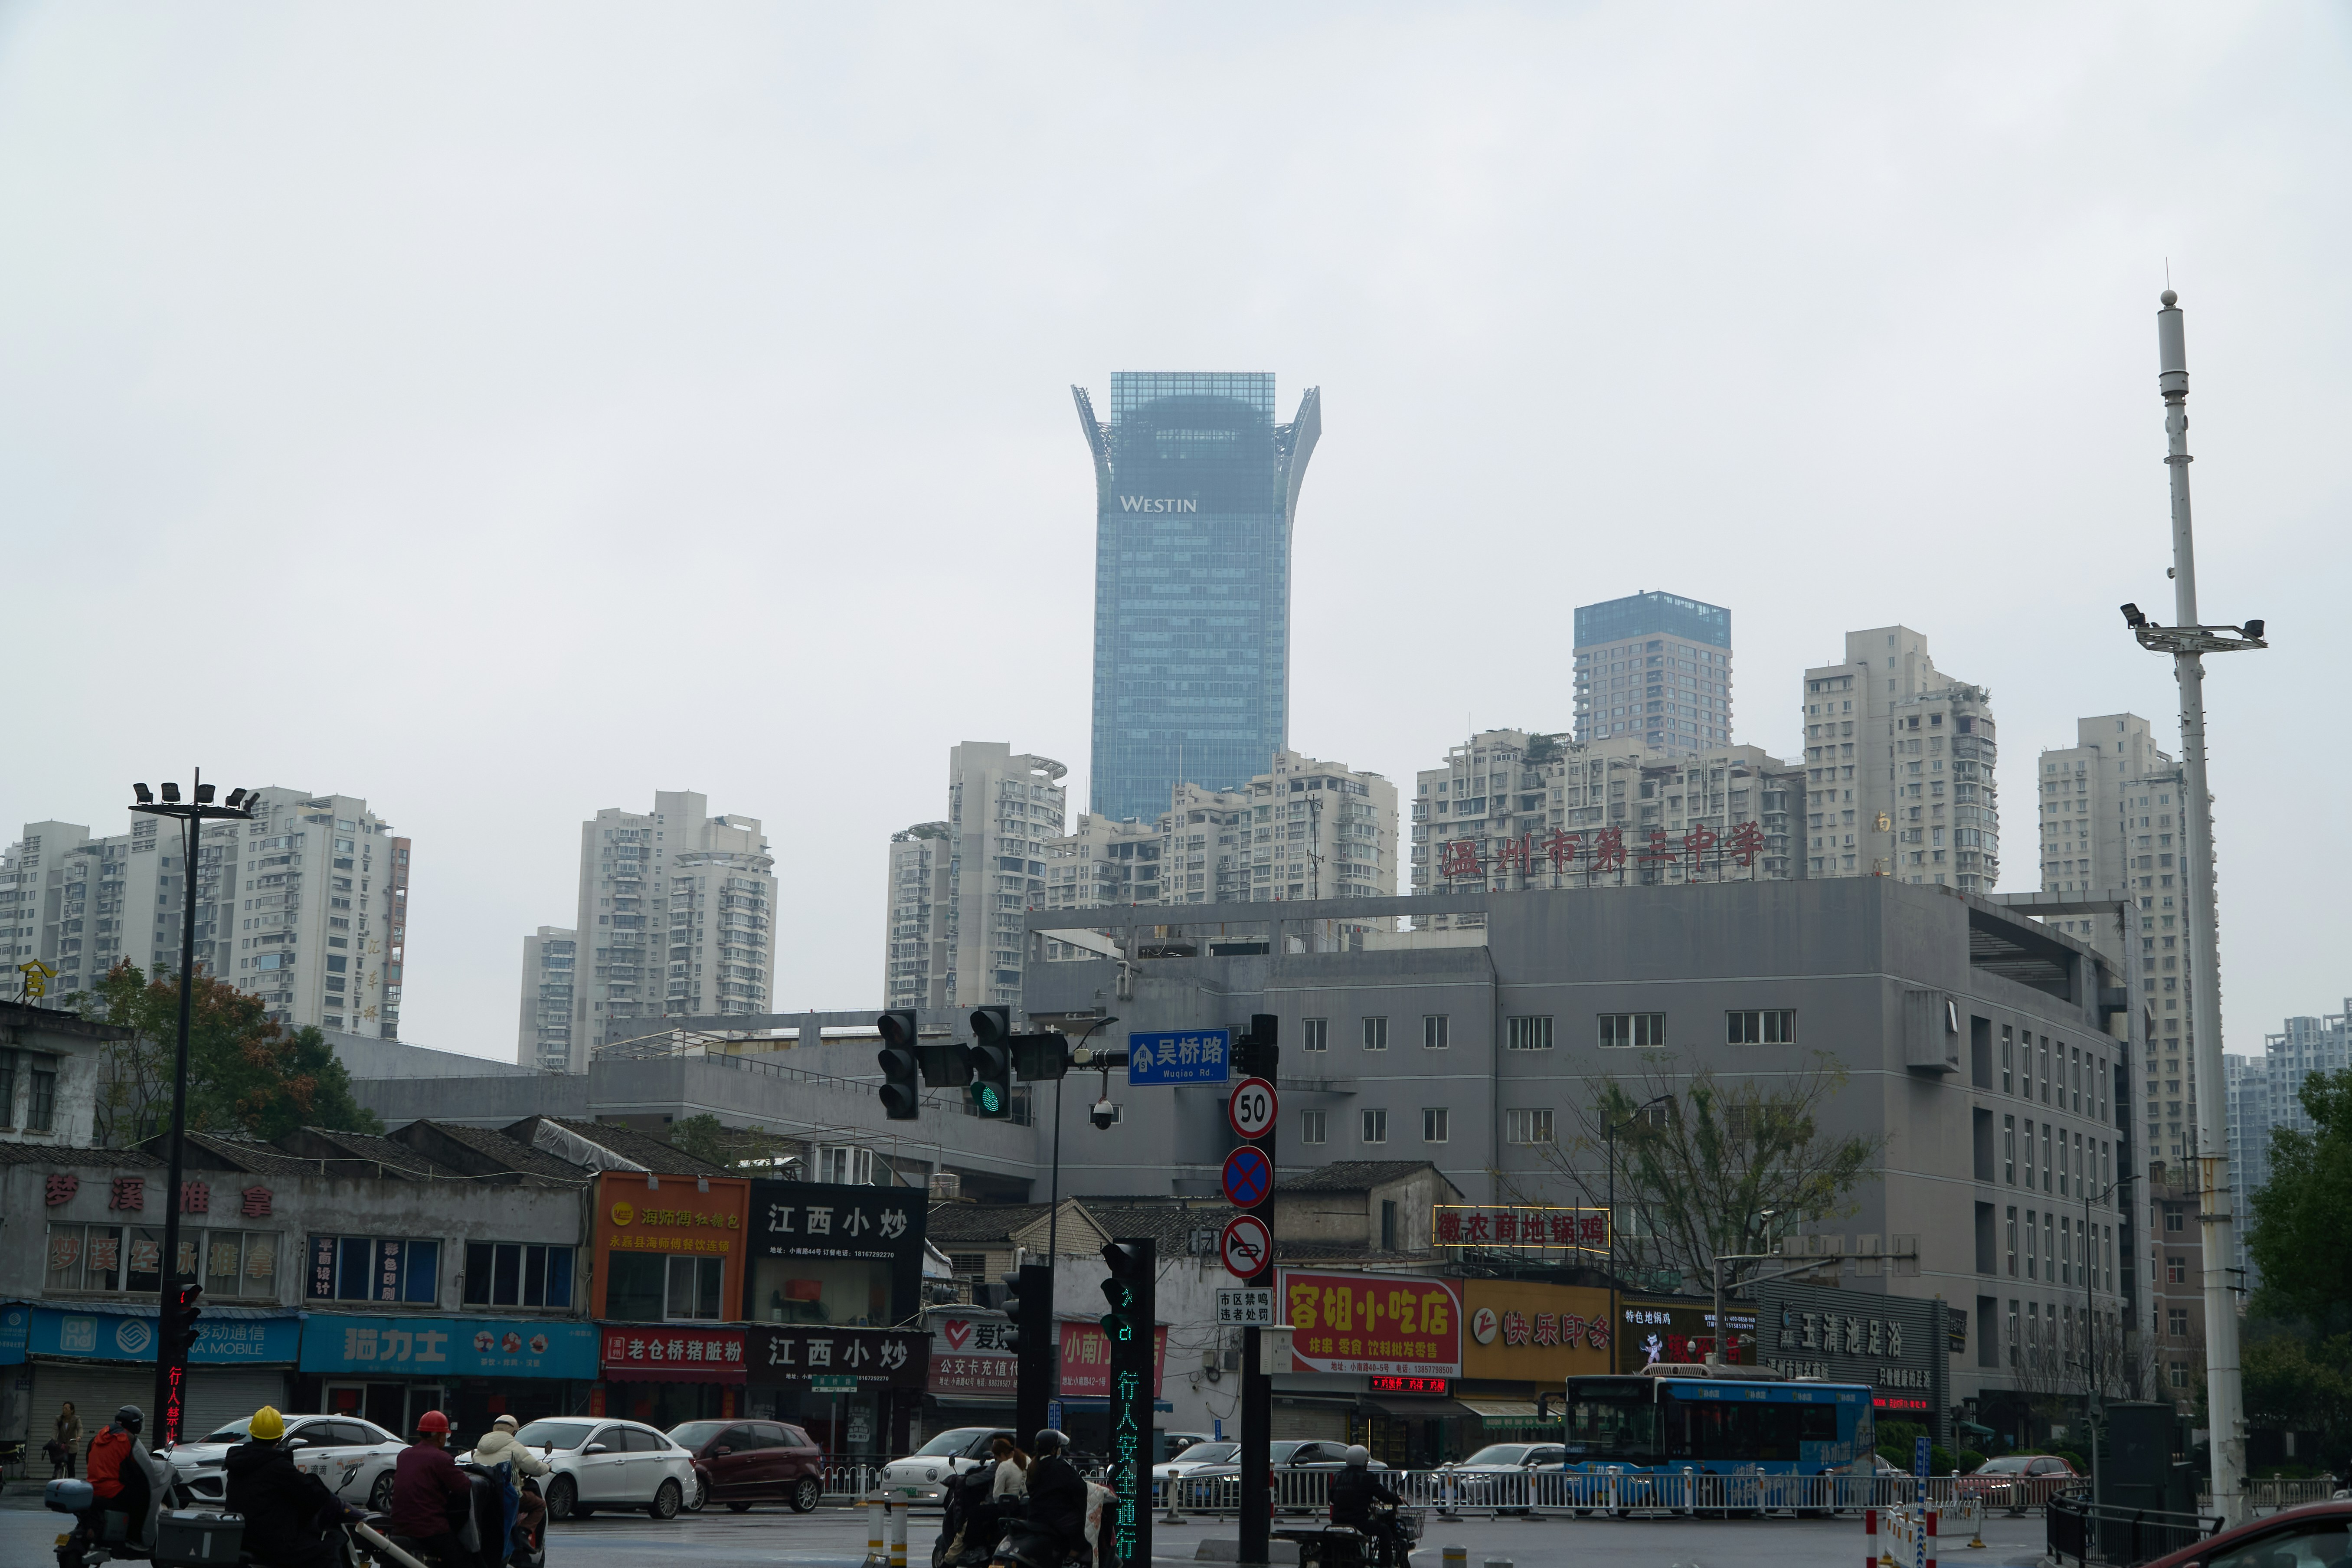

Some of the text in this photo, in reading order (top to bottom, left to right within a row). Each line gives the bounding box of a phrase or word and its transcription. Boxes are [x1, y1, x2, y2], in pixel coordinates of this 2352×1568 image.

[1120, 495, 1196, 513] WESTIN
[1443, 820, 1767, 878] 温州市第三中学
[1140, 1049, 1146, 1059] 南
[1156, 1036, 1223, 1066] 吴桥路
[1164, 1068, 1214, 1079] Wuqiao Rd.
[1241, 1094, 1265, 1123] 50
[46, 1174, 274, 1217] 梦溪推拿
[641, 1208, 740, 1229] 海师傅红糖包
[768, 1203, 907, 1240] 江西小炒
[1438, 1213, 1604, 1245] 徽农商地锅鸡
[51, 1236, 274, 1279] 梦溪经脉推拿
[610, 1235, 729, 1253] 永嘉县海师傅餐饮连锁
[316, 1238, 333, 1295] 平面设计
[381, 1242, 399, 1301] 彩色印刷
[1220, 1293, 1269, 1306] 市区禁鸣
[1289, 1282, 1449, 1336] 容姐小吃店
[1220, 1308, 1269, 1321] 违者处罚
[1626, 1309, 1671, 1325] 特色地锅鸡
[1503, 1310, 1610, 1350] 快乐印务
[1801, 1313, 1903, 1357] 玉清池足浴
[210, 1342, 264, 1355] MOBILE
[343, 1328, 448, 1362] 猫力士
[612, 1339, 622, 1357] 温州
[628, 1338, 742, 1362] 老仓桥猪脏粉
[769, 1336, 908, 1371] 江西小炒
[1309, 1337, 1438, 1359] 炸串 零食 饮料批发零售
[1396, 1364, 1453, 1374] 电话：13857798500
[1878, 1367, 1930, 1388] 只做健康的足浴
[166, 1366, 183, 1446] 行人禁止
[311, 1464, 327, 1475] 滴滴
[1116, 1370, 1139, 1559] 行人安全通行
